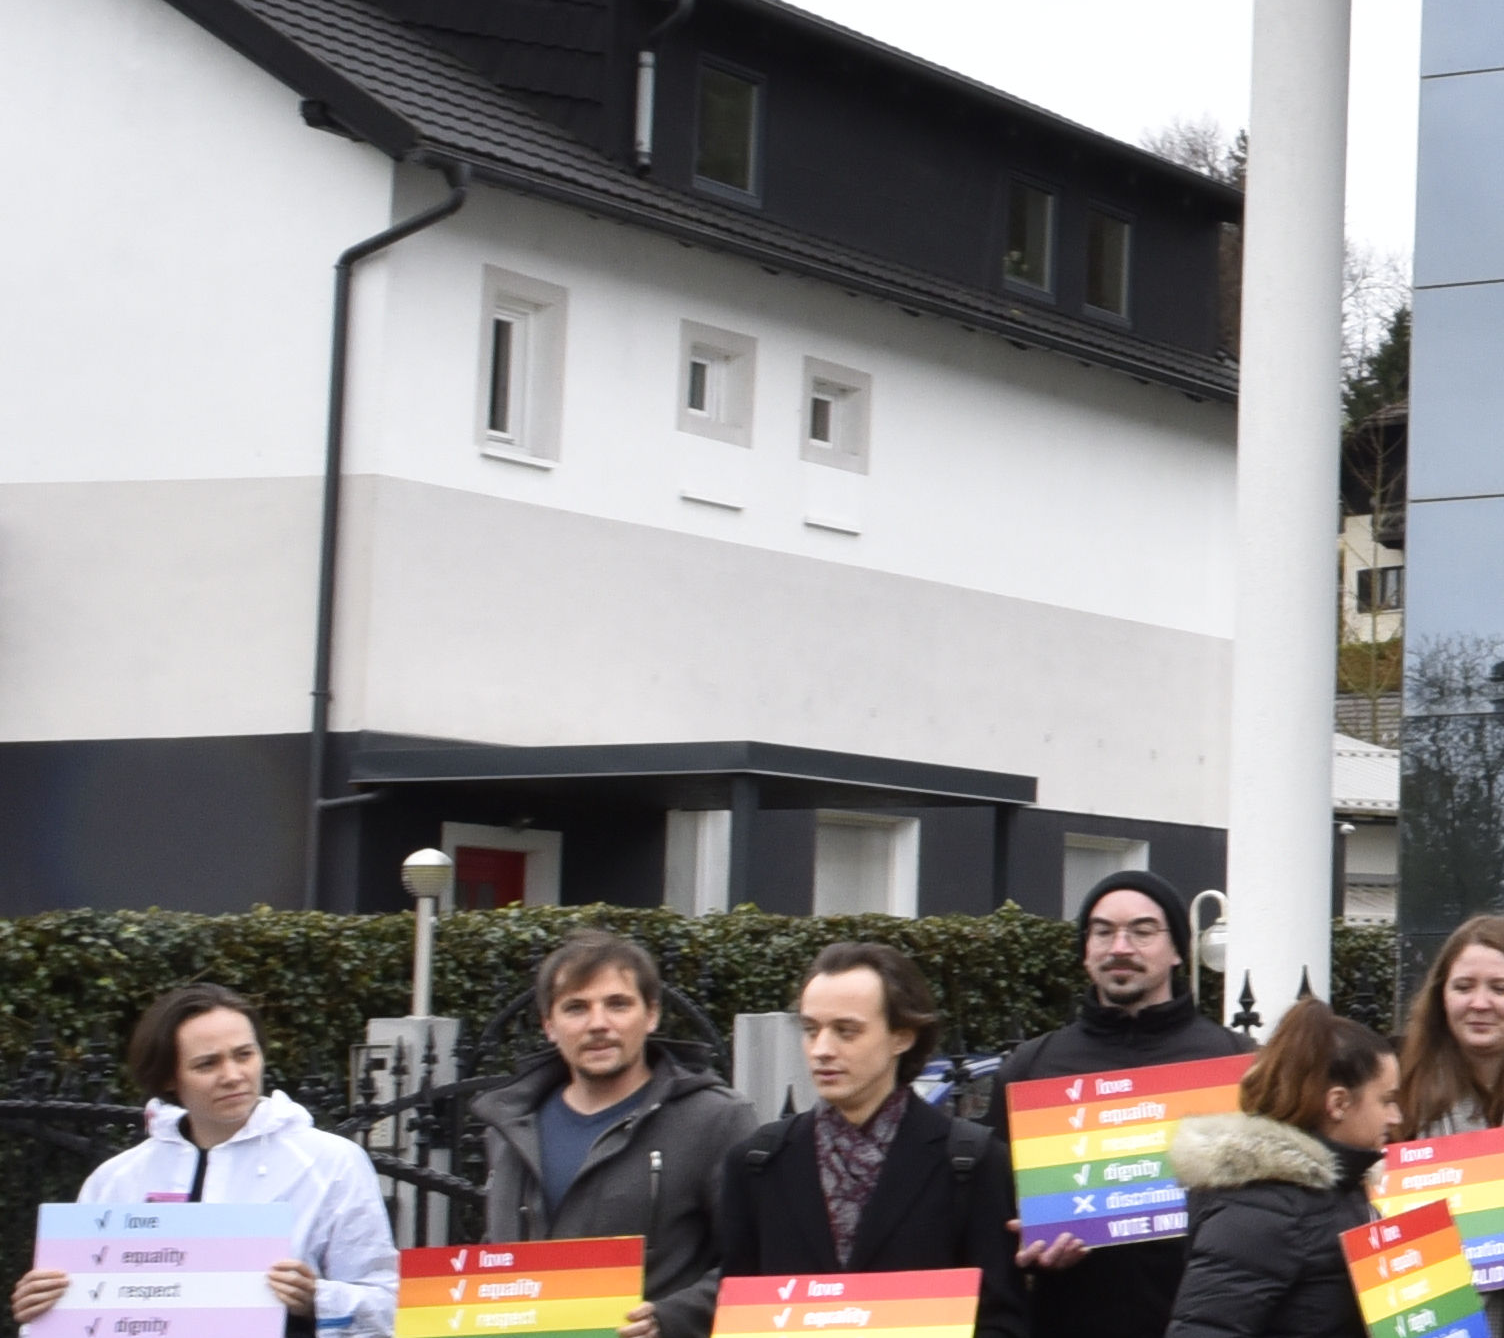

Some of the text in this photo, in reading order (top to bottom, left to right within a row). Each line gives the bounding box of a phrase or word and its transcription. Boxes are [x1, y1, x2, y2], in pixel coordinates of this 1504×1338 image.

[1095, 1078, 1133, 1096] love
[1098, 1102, 1167, 1124] equality
[1400, 1147, 1434, 1163] love
[1103, 1160, 1162, 1182] dignity
[1401, 1167, 1463, 1190] equality
[124, 1212, 159, 1229] love
[122, 1247, 186, 1267] equality
[479, 1250, 514, 1268] love
[118, 1283, 181, 1300] respect
[477, 1278, 543, 1299] equality
[807, 1280, 844, 1297] love
[114, 1316, 170, 1336] dignity
[803, 1307, 872, 1328] equality
